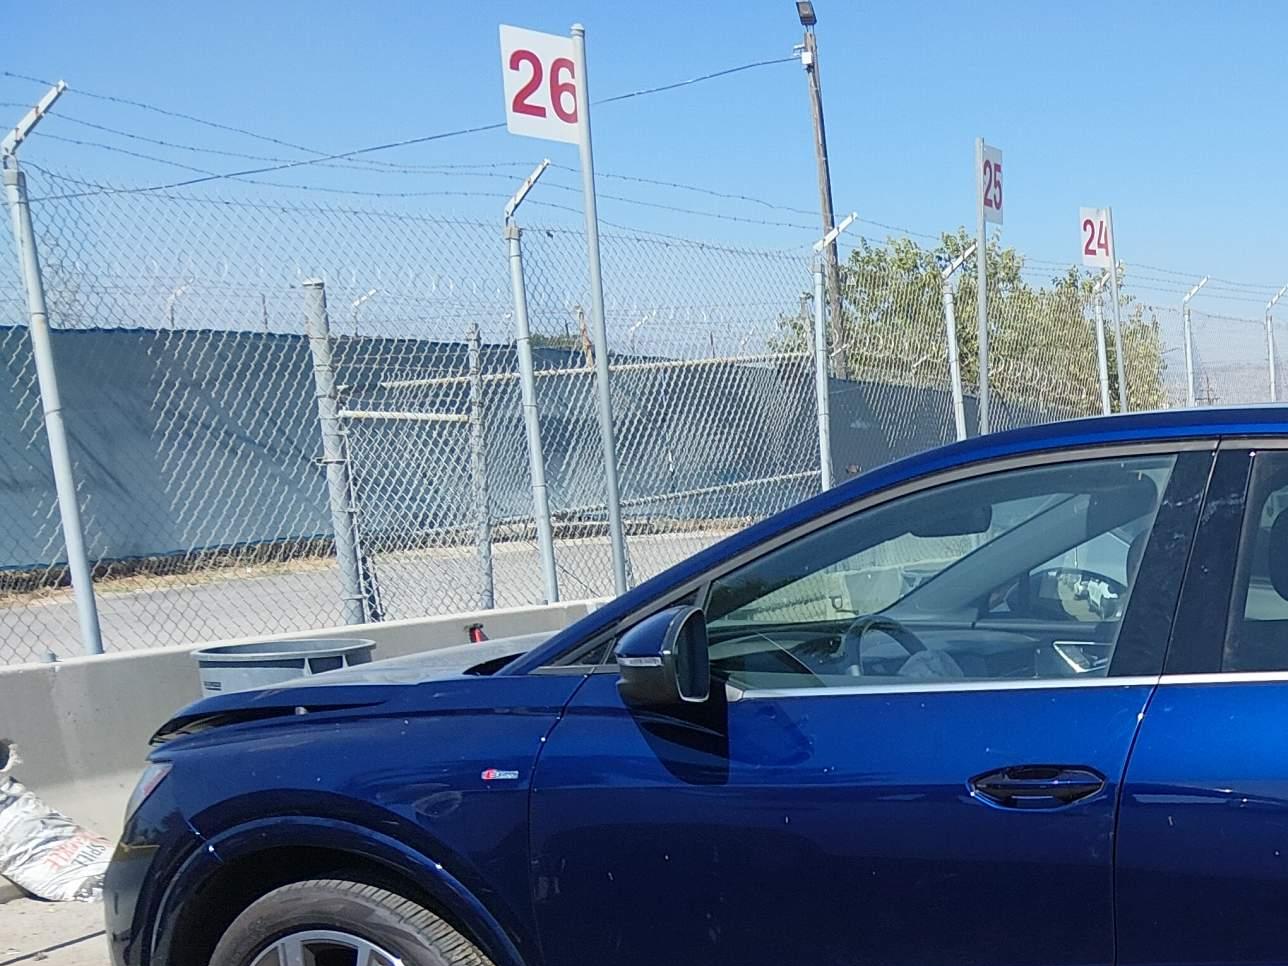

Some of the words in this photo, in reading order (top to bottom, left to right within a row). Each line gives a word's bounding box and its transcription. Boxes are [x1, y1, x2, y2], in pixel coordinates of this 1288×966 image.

[509, 49, 579, 124] 26
[983, 159, 1003, 210] 25
[1082, 218, 1110, 257] 24
[70, 841, 106, 867] SPILL
